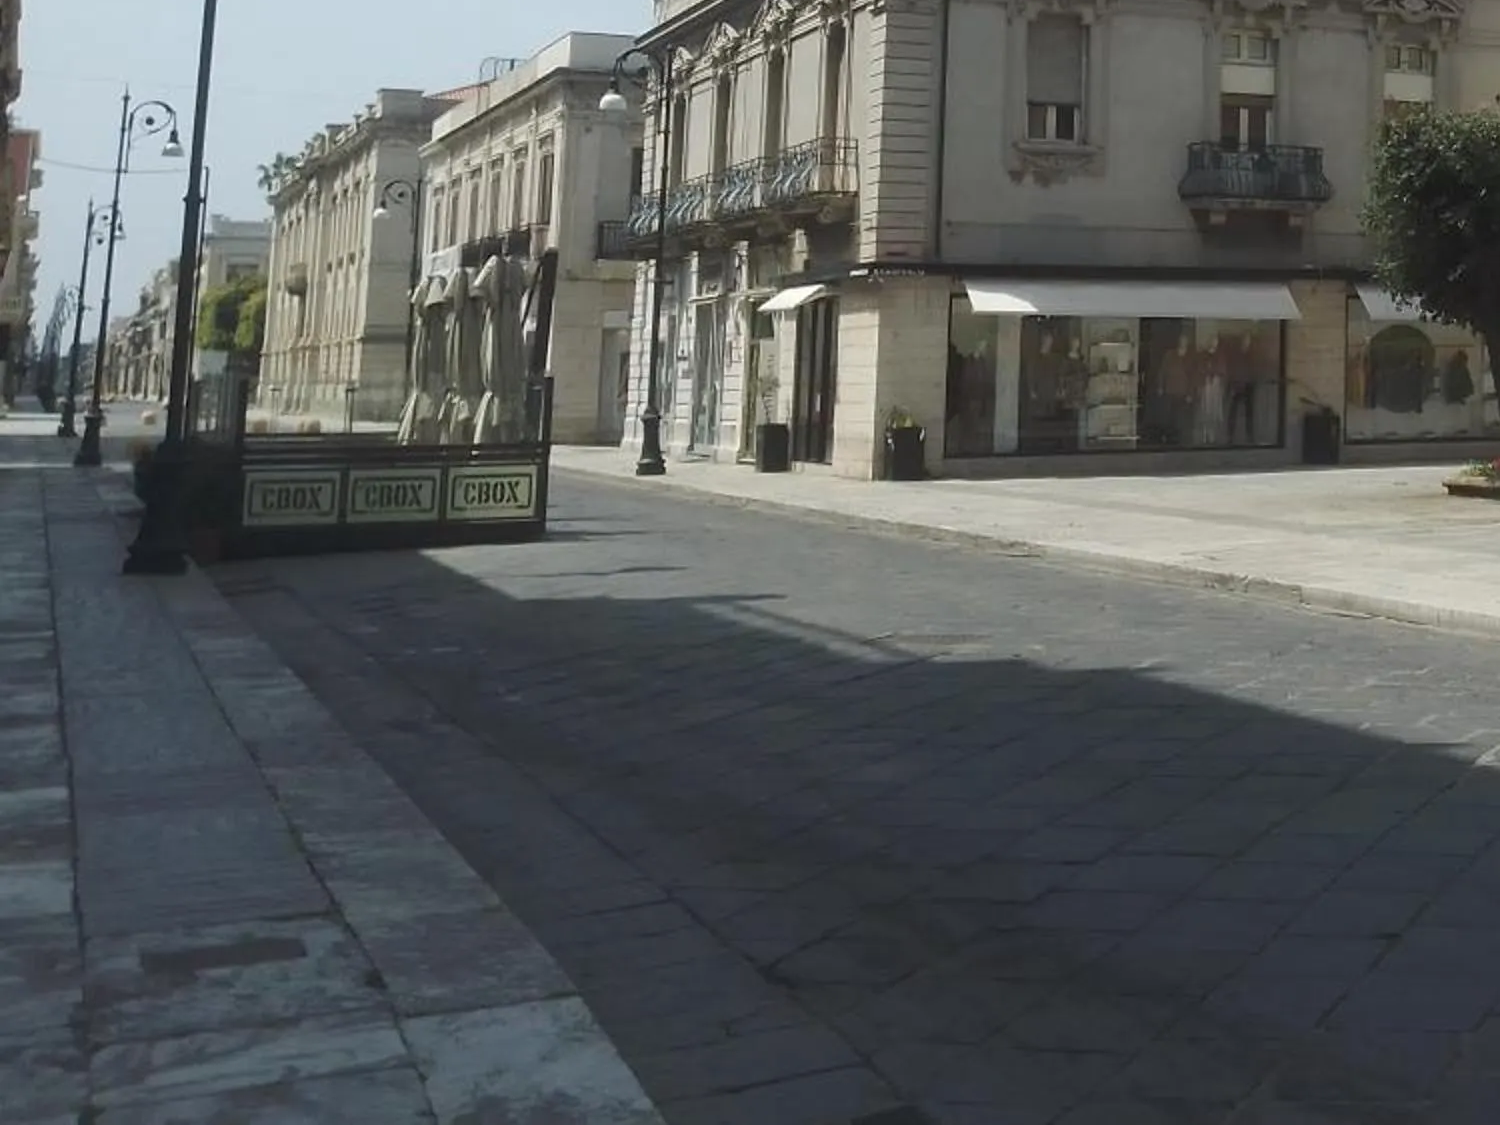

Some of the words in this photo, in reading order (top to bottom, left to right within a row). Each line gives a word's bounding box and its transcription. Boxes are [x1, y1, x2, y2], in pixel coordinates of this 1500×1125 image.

[261, 484, 322, 510] CBOX
[365, 482, 422, 507] CBOX
[463, 480, 520, 505] CBOX
